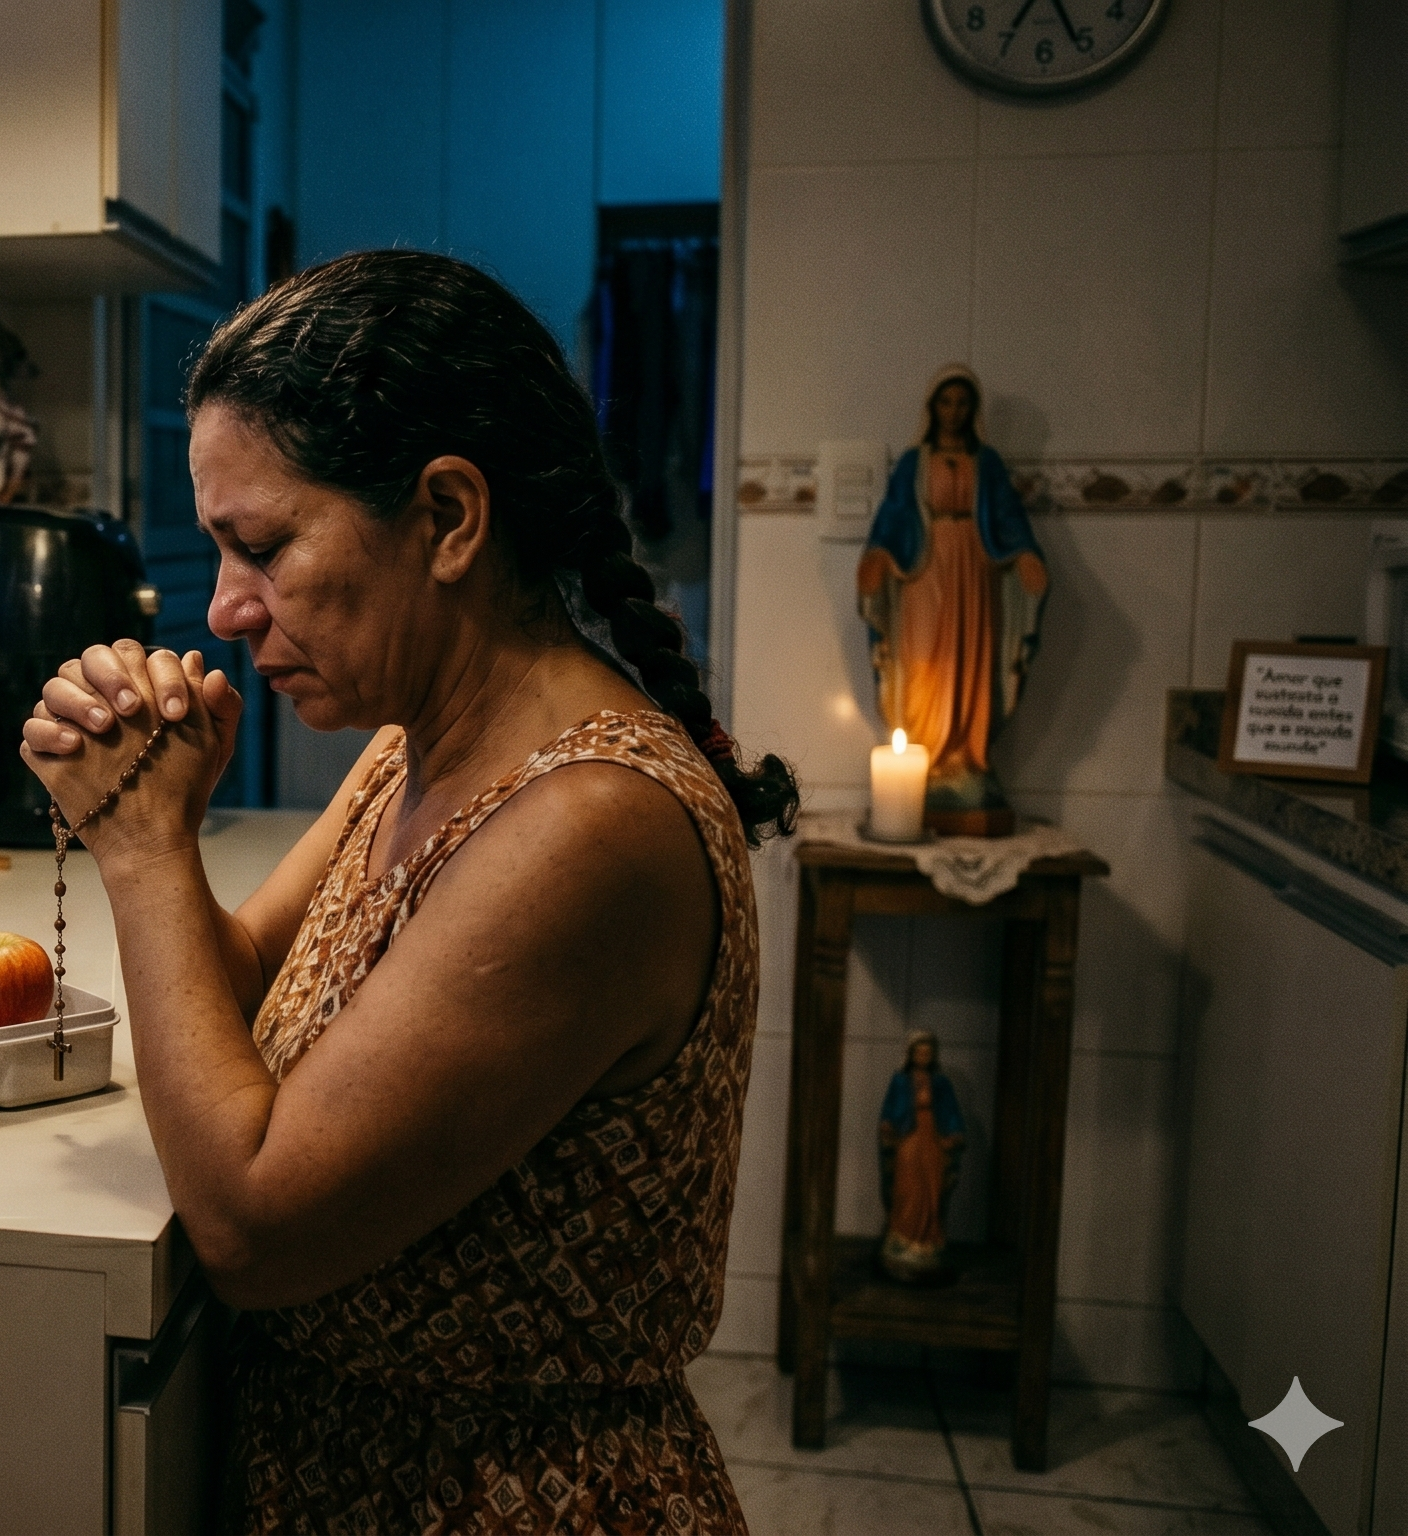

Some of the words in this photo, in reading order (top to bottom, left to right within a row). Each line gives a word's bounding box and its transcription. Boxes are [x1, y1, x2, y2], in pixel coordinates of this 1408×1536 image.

[966, 6, 985, 31] 8
[1106, 0, 1125, 21] 4
[998, 30, 1016, 56] 7
[1034, 38, 1053, 64] 6
[1076, 27, 1094, 53] 5
